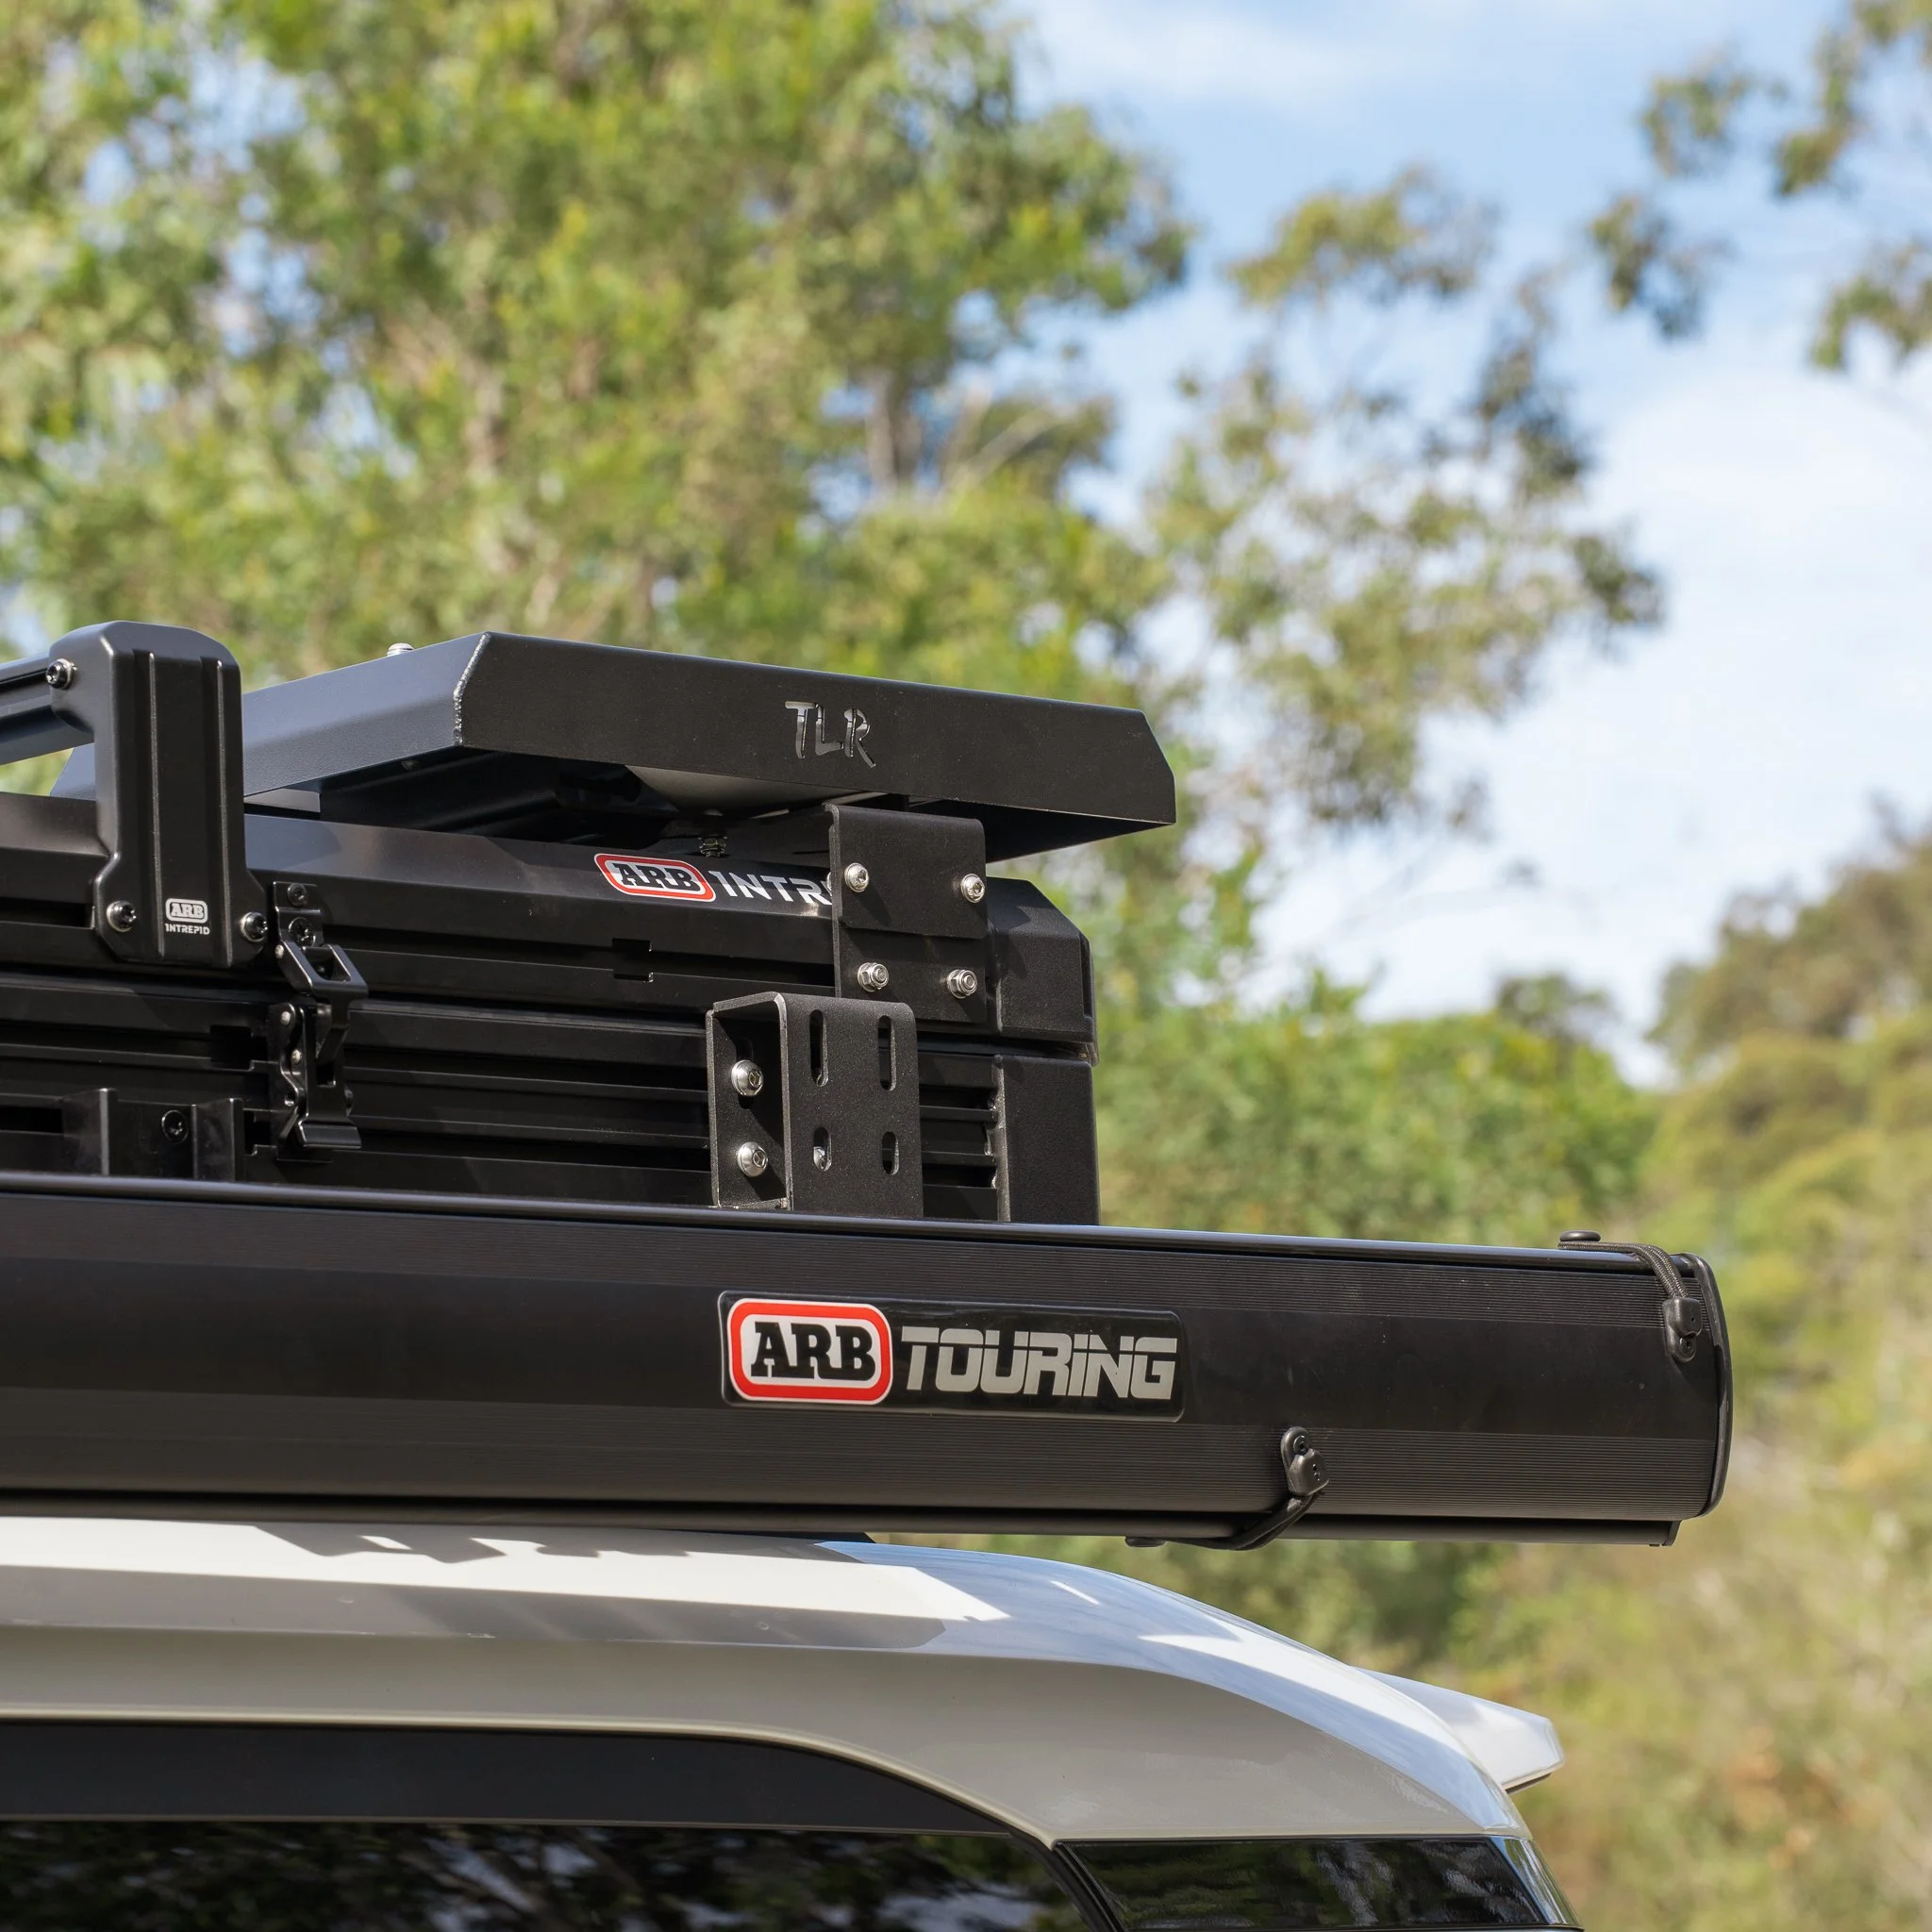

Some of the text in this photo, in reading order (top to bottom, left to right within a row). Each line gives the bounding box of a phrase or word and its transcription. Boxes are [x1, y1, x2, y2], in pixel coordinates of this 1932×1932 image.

[785, 700, 875, 768] TLR
[613, 863, 832, 906] ARB INTR
[164, 923, 210, 935] INTREPID
[171, 903, 204, 919] ARB
[750, 1321, 1177, 1400] ARB TOURING
